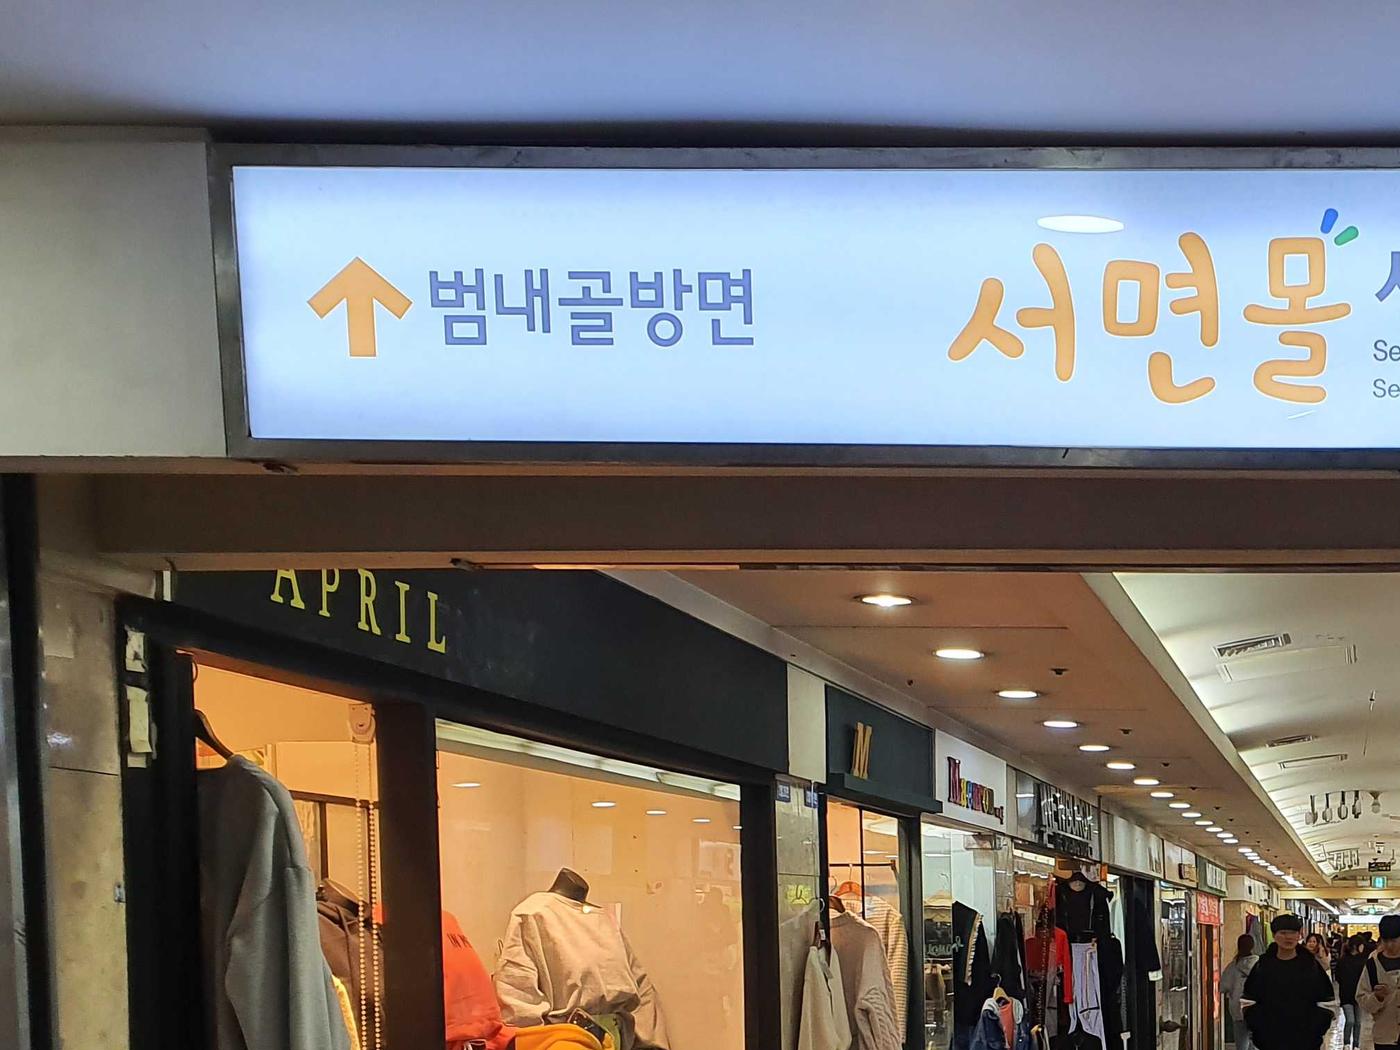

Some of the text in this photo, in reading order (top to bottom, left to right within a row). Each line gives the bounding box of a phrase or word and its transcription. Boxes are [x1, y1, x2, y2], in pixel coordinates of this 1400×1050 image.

[428, 267, 755, 348] 범내골방면
[948, 233, 1352, 405] 서면몰
[269, 568, 447, 654] APRIL
